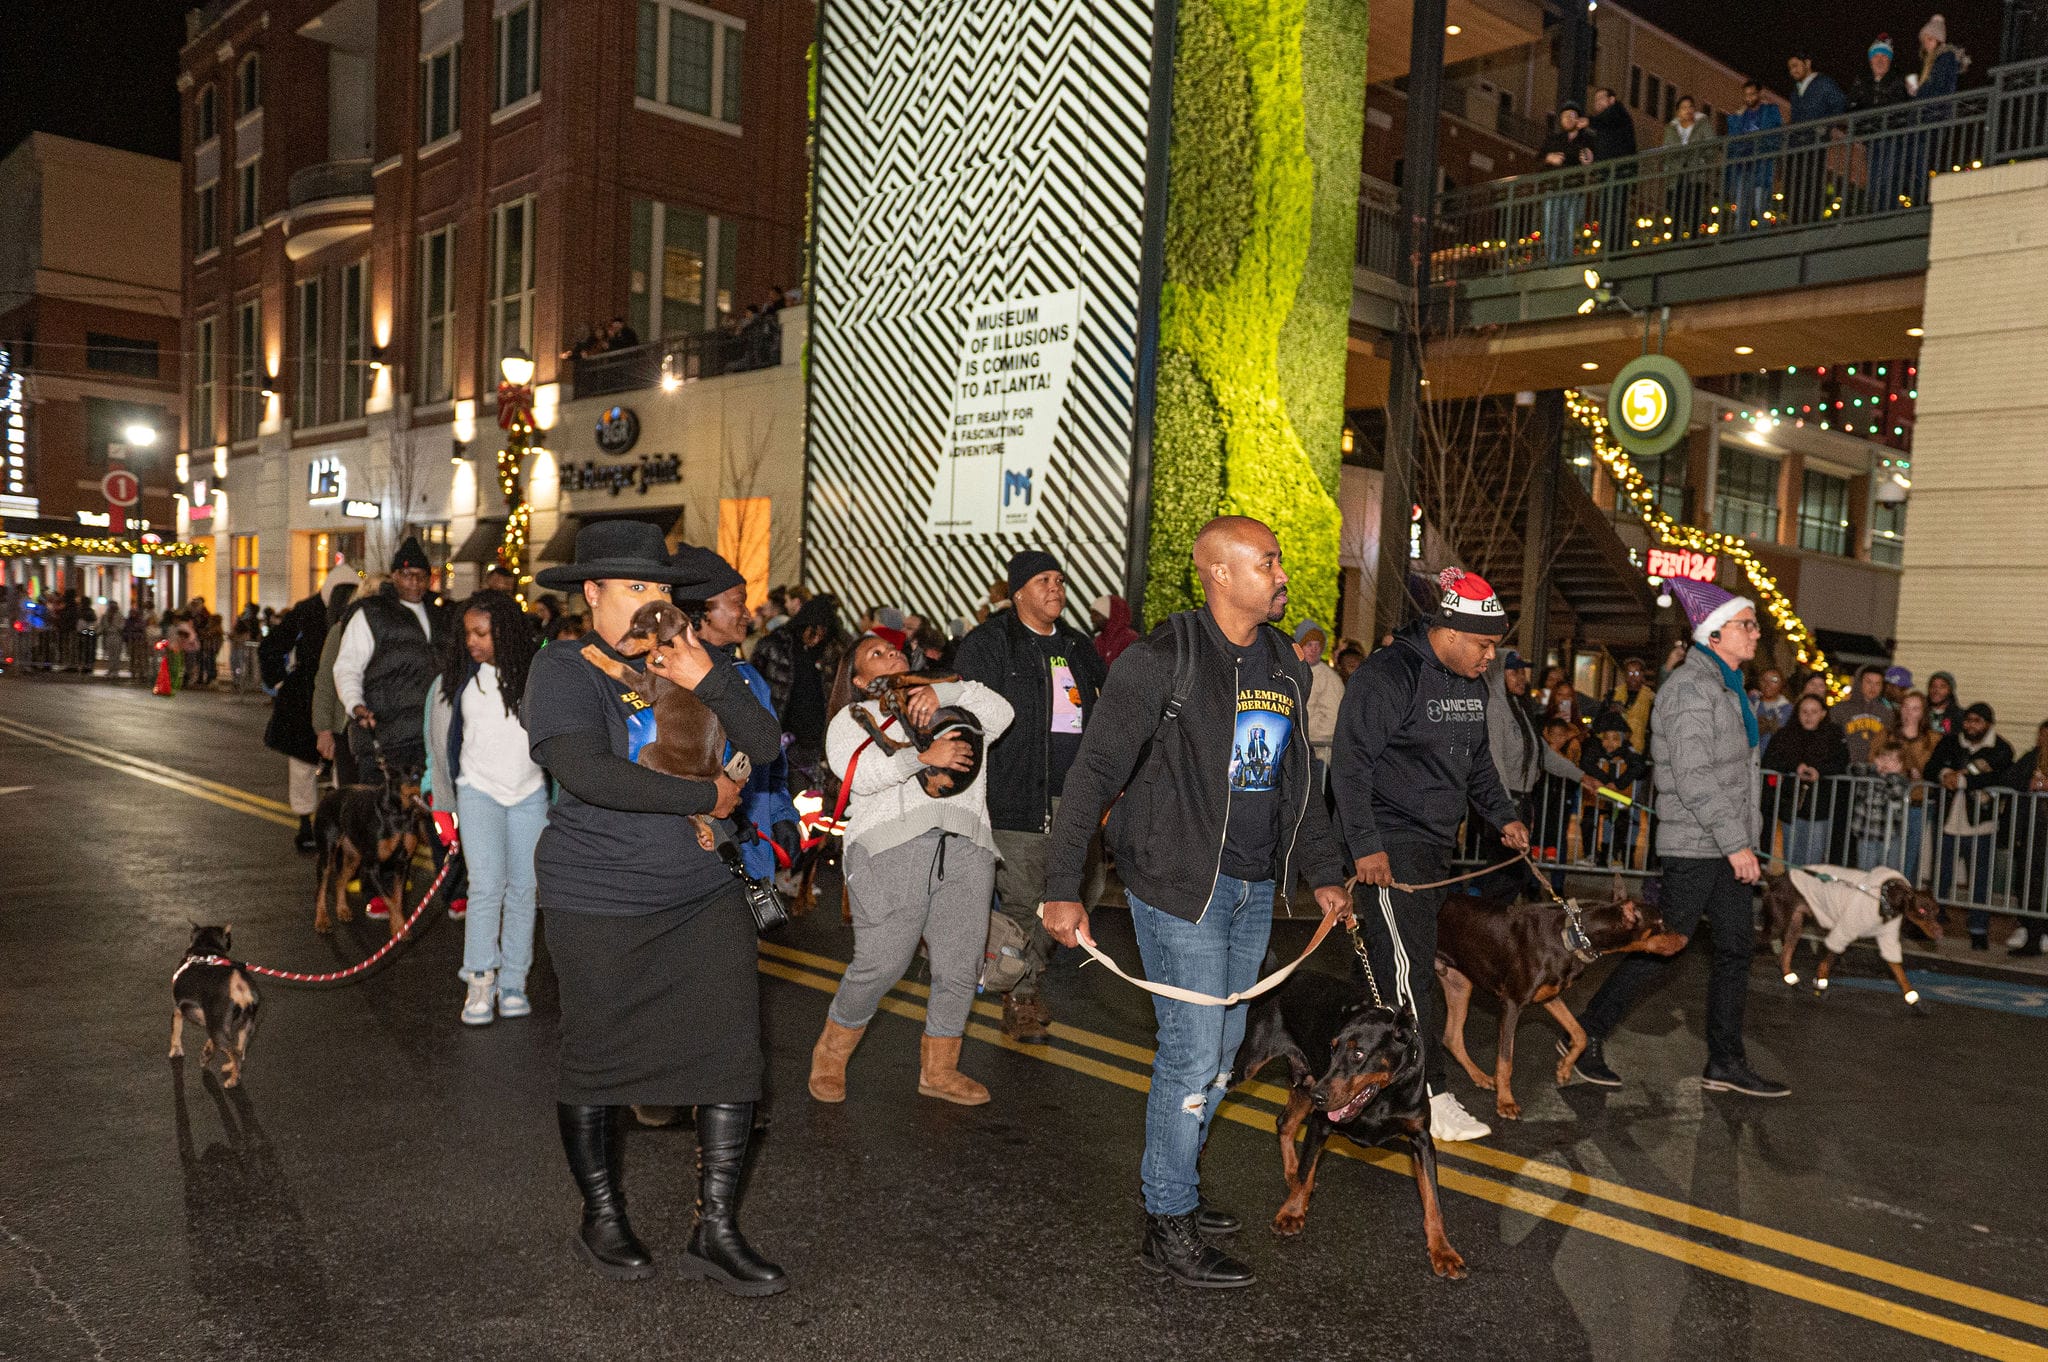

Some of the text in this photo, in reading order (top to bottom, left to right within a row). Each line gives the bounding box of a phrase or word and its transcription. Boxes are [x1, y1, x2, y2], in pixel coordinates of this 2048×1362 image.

[976, 307, 1038, 330] MUSEUM
[971, 324, 1069, 354] OF ILLUSIONS
[966, 352, 1040, 376] IS COMING
[962, 372, 1051, 399] TO ATLANTA!
[955, 414, 974, 425] GET
[1013, 407, 1033, 420] FOR
[1633, 385, 1656, 425] 5
[117, 477, 127, 499] 1
[1440, 699, 1484, 711] UNDER
[1445, 712, 1485, 722] ARMOUR
